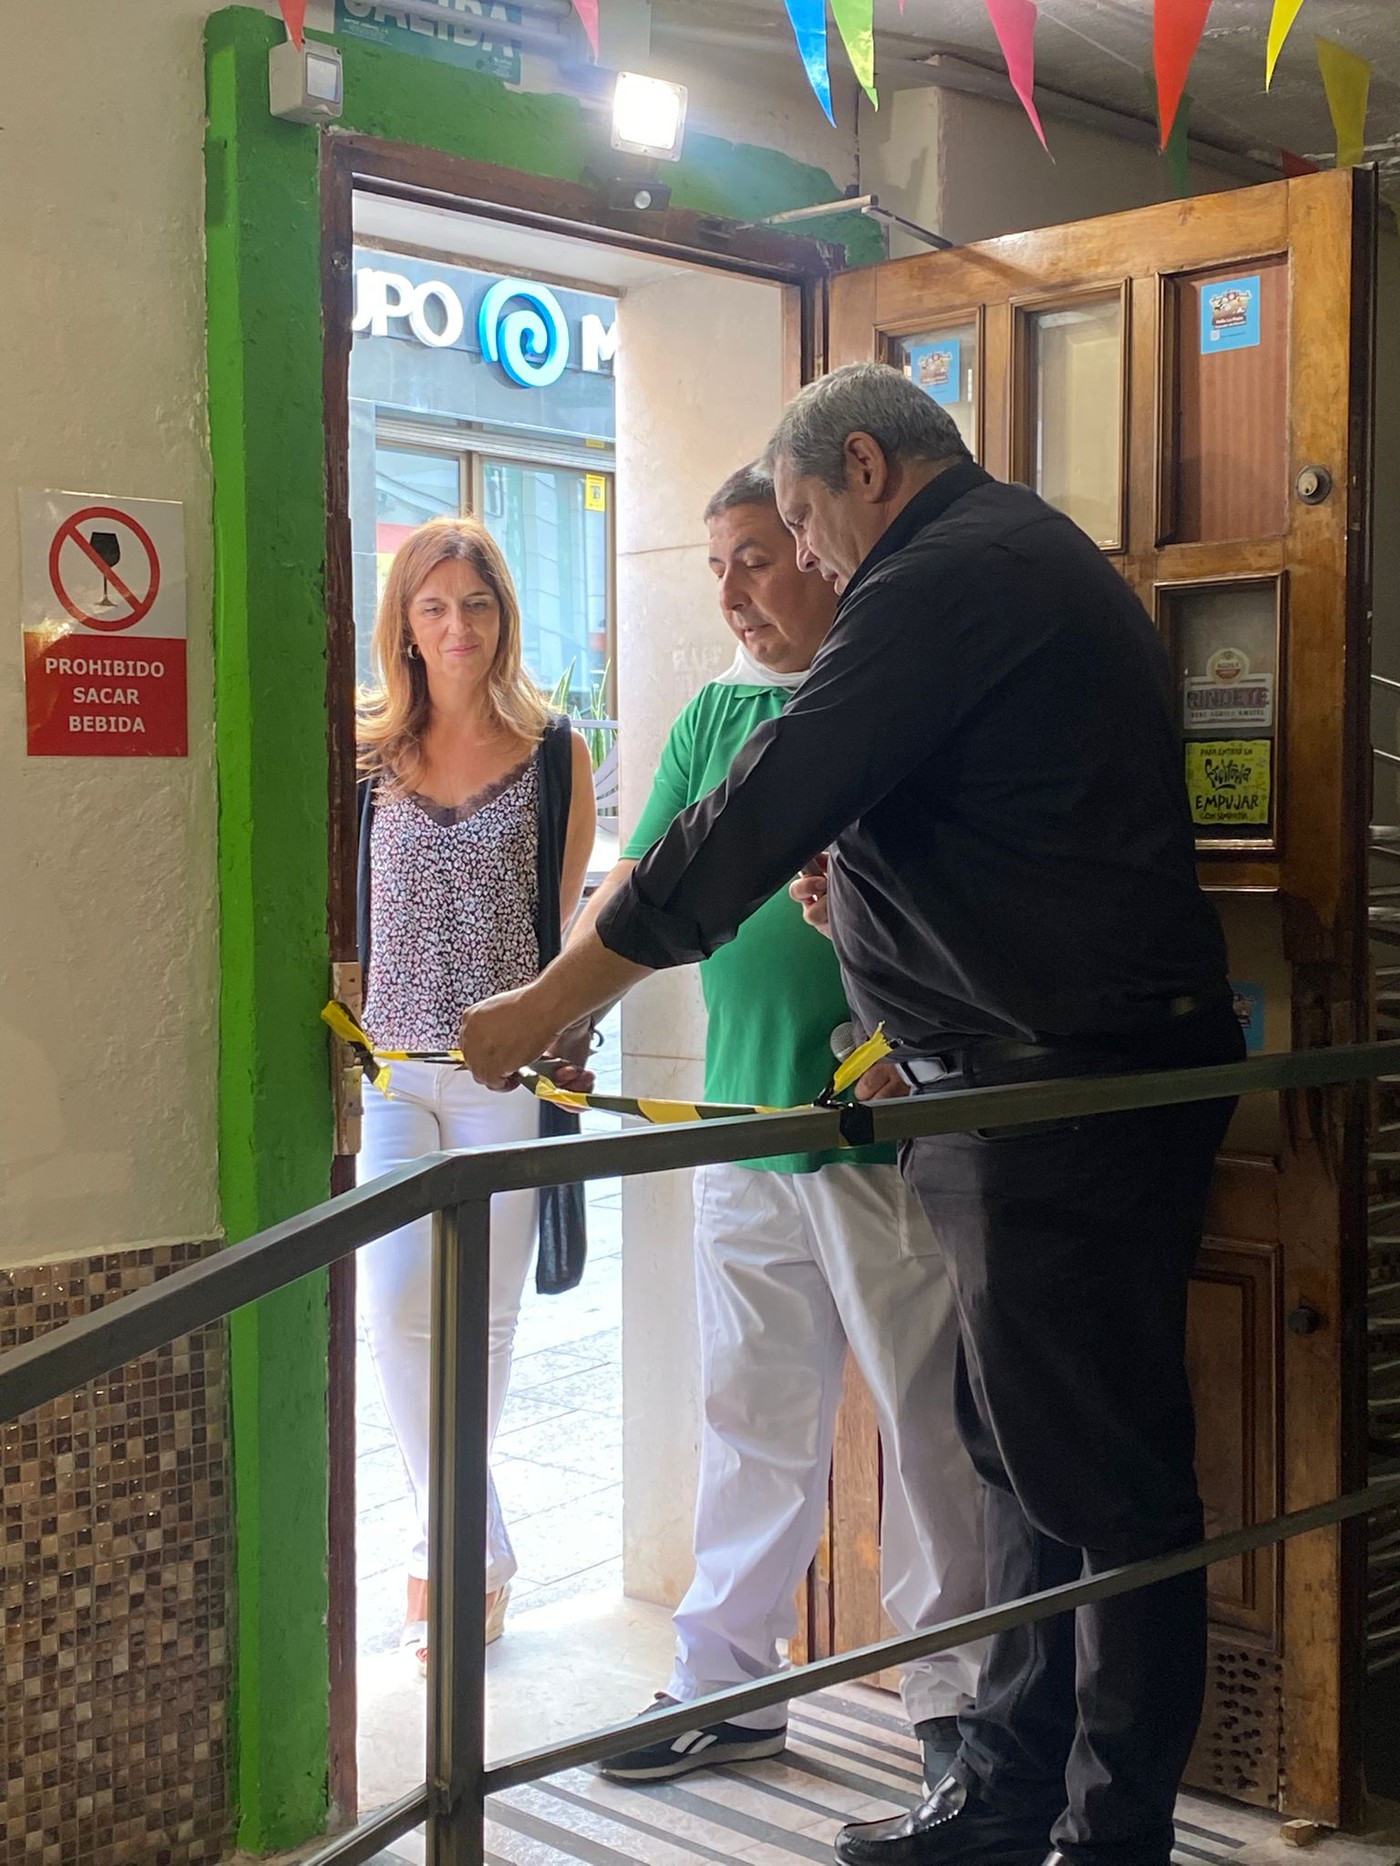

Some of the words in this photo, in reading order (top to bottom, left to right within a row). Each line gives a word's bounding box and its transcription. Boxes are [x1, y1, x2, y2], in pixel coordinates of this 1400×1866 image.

[45, 657, 165, 678] PROHIBIDO
[73, 687, 140, 705] SACAR
[69, 715, 146, 733] BEBIDA
[1196, 794, 1259, 812] EMPUJAR
